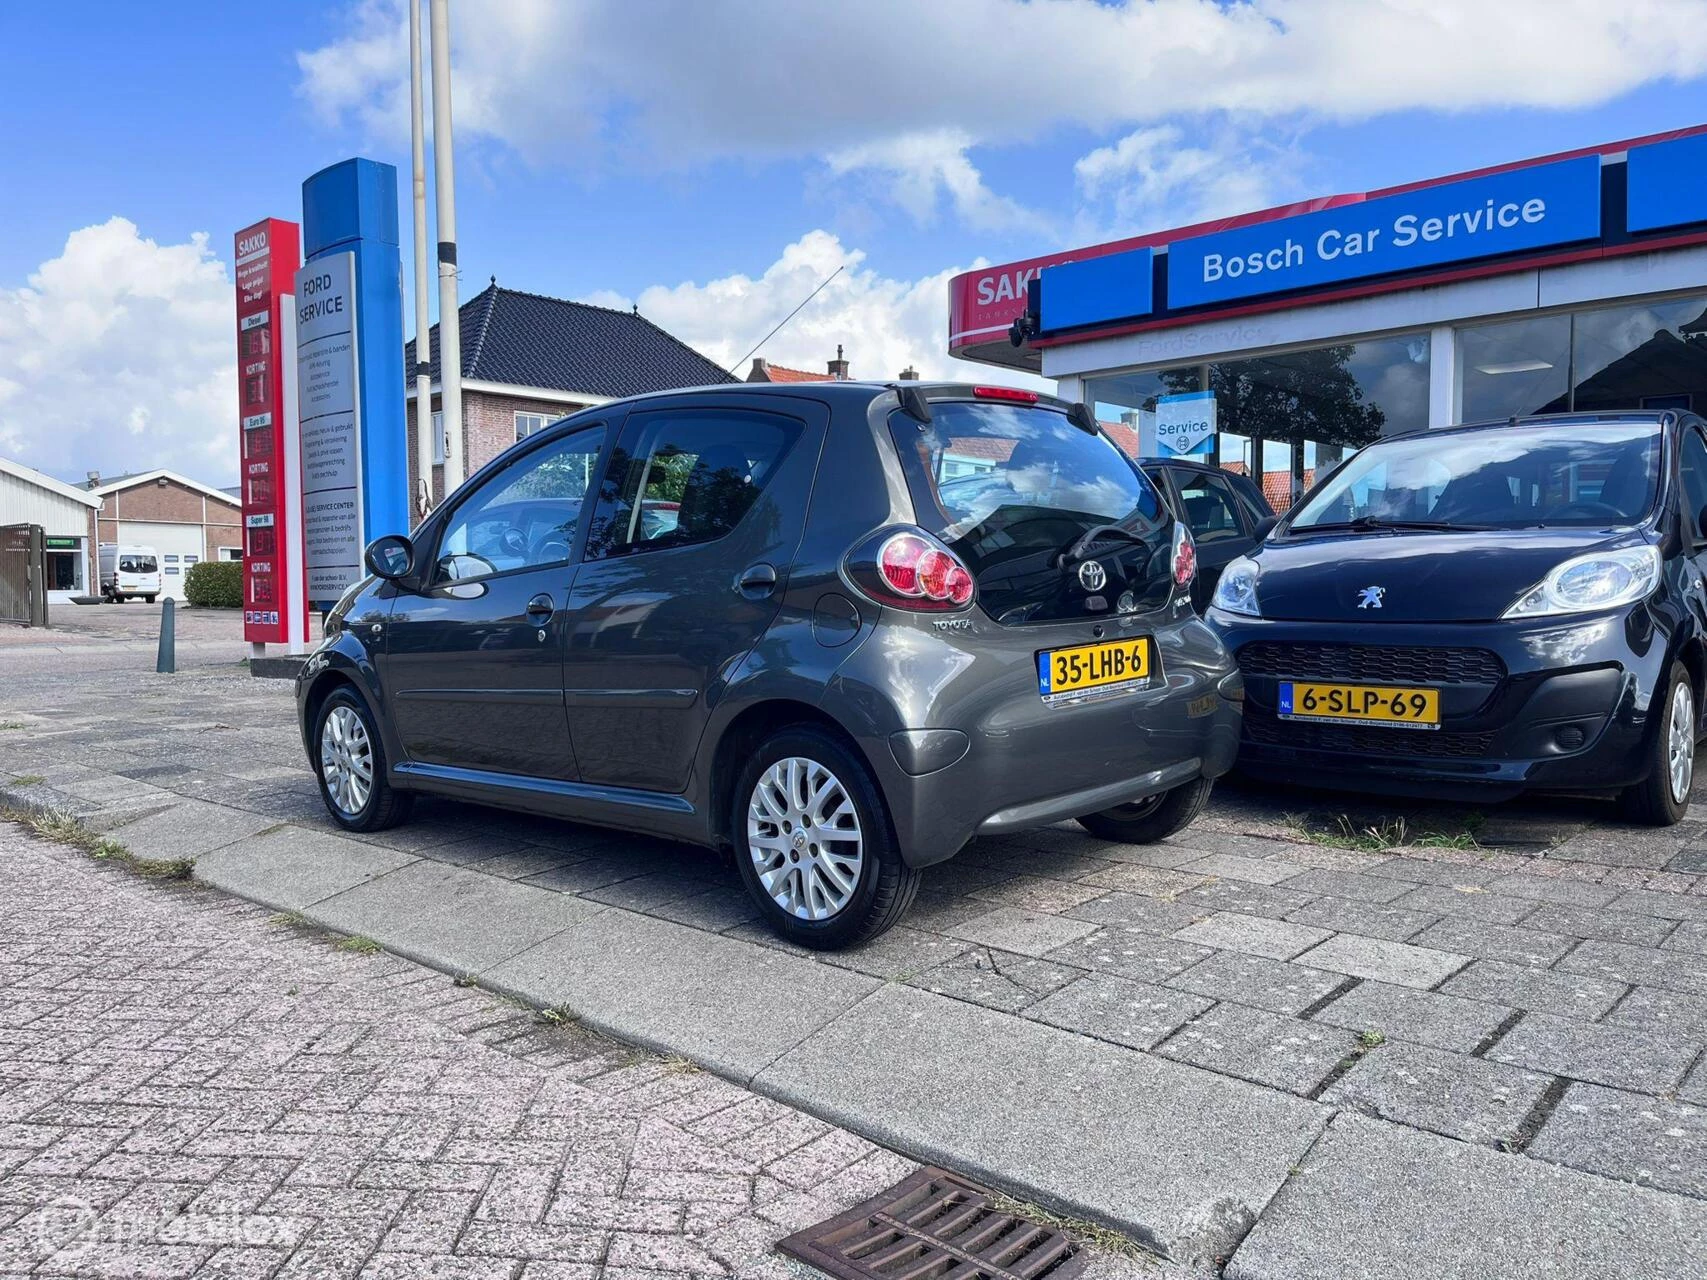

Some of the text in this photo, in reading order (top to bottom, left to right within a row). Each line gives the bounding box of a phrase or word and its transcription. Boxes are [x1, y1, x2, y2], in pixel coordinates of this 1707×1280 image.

[238, 232, 266, 256] SAKKO
[1203, 198, 1546, 283] Bosch Car Service
[303, 274, 332, 298] FORD
[977, 265, 1044, 305] SAK
[299, 296, 343, 325] SERVICE
[1158, 420, 1208, 436] Service
[248, 462, 269, 474] KORTING
[334, 502, 354, 510] CENTER
[932, 619, 973, 631] TOYOTA
[1056, 645, 1142, 686] 35-LHB-6
[1040, 678, 1049, 687] NL
[1281, 701, 1292, 709] NL
[1302, 688, 1427, 718] 6-SLP-69
